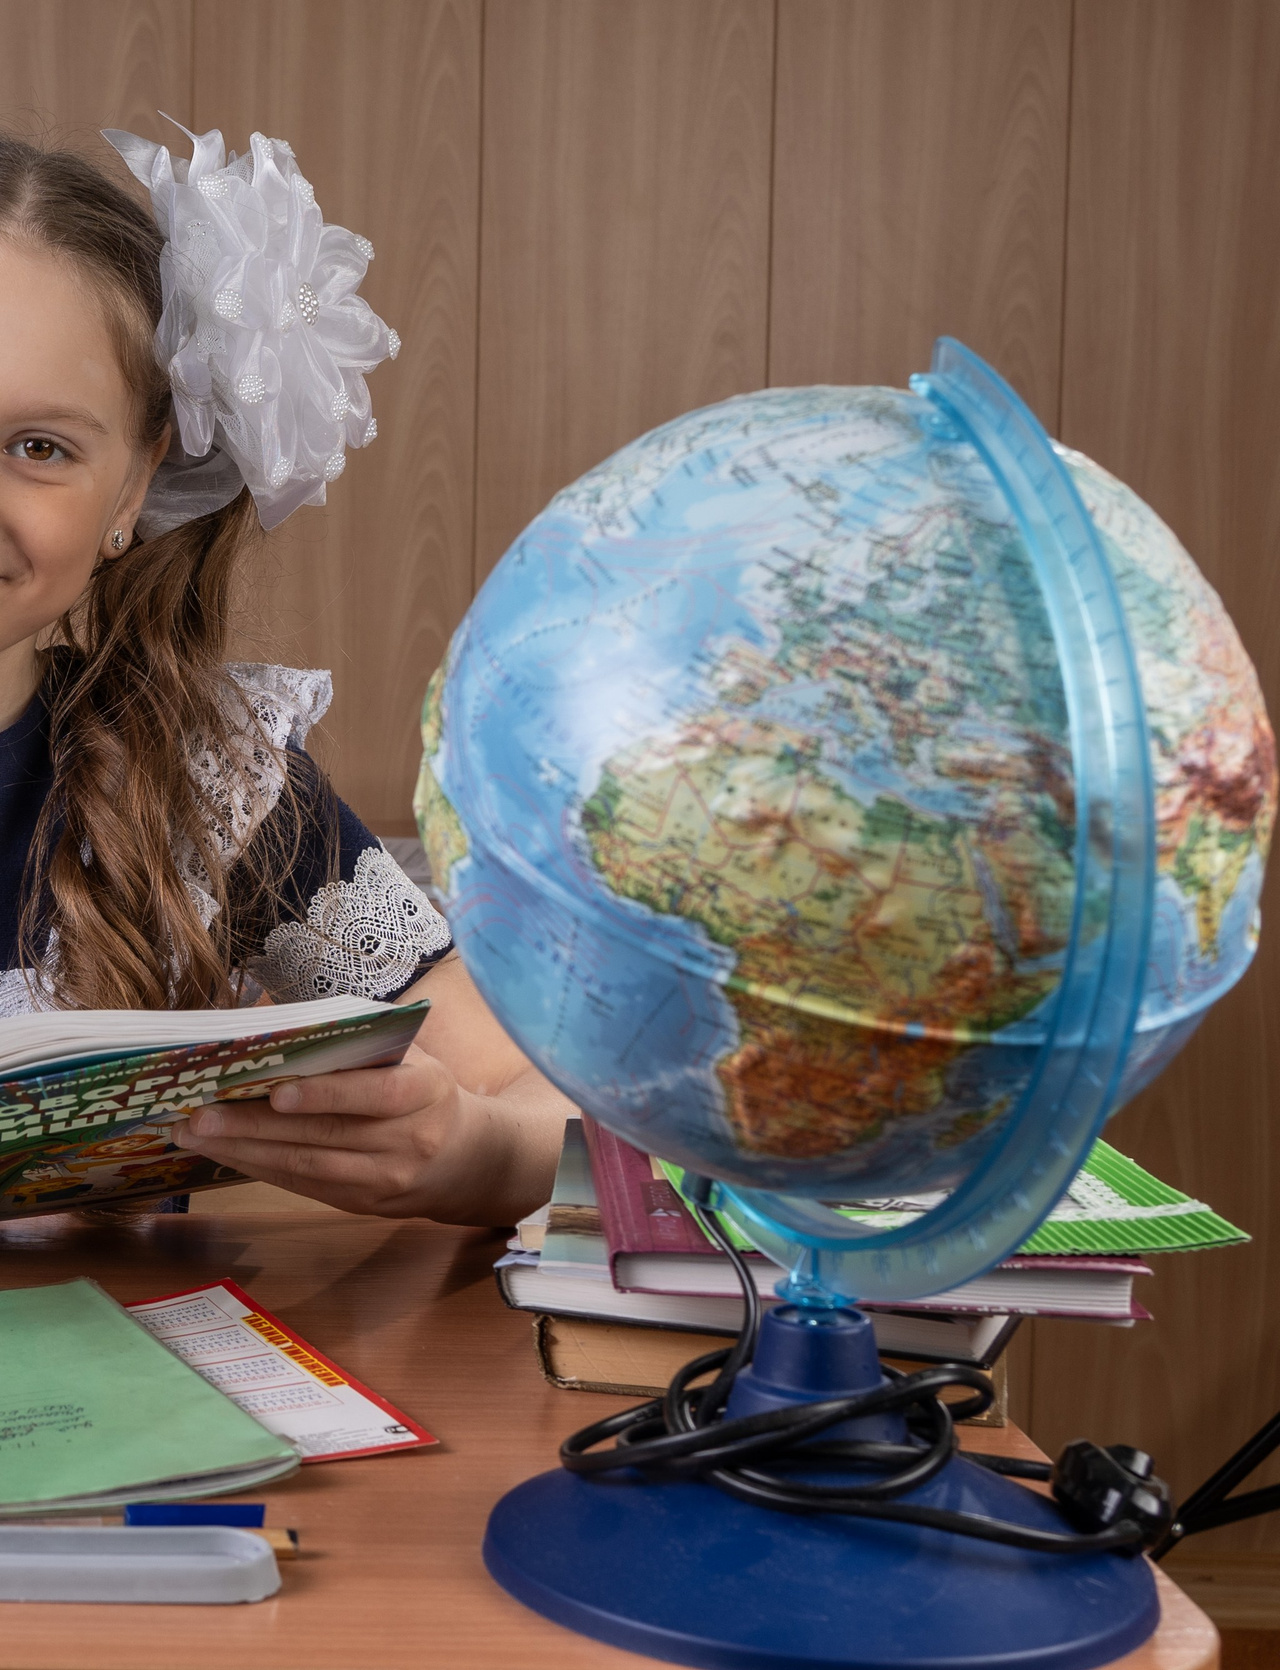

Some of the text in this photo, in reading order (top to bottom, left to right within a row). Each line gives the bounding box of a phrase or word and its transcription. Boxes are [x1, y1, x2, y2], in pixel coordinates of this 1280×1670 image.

[246, 1024, 372, 1052] КАРАШЕВА
[240, 1311, 293, 1348] ТАБЛИЦА
[278, 1343, 349, 1388] УМНОЖЕНИЯ
